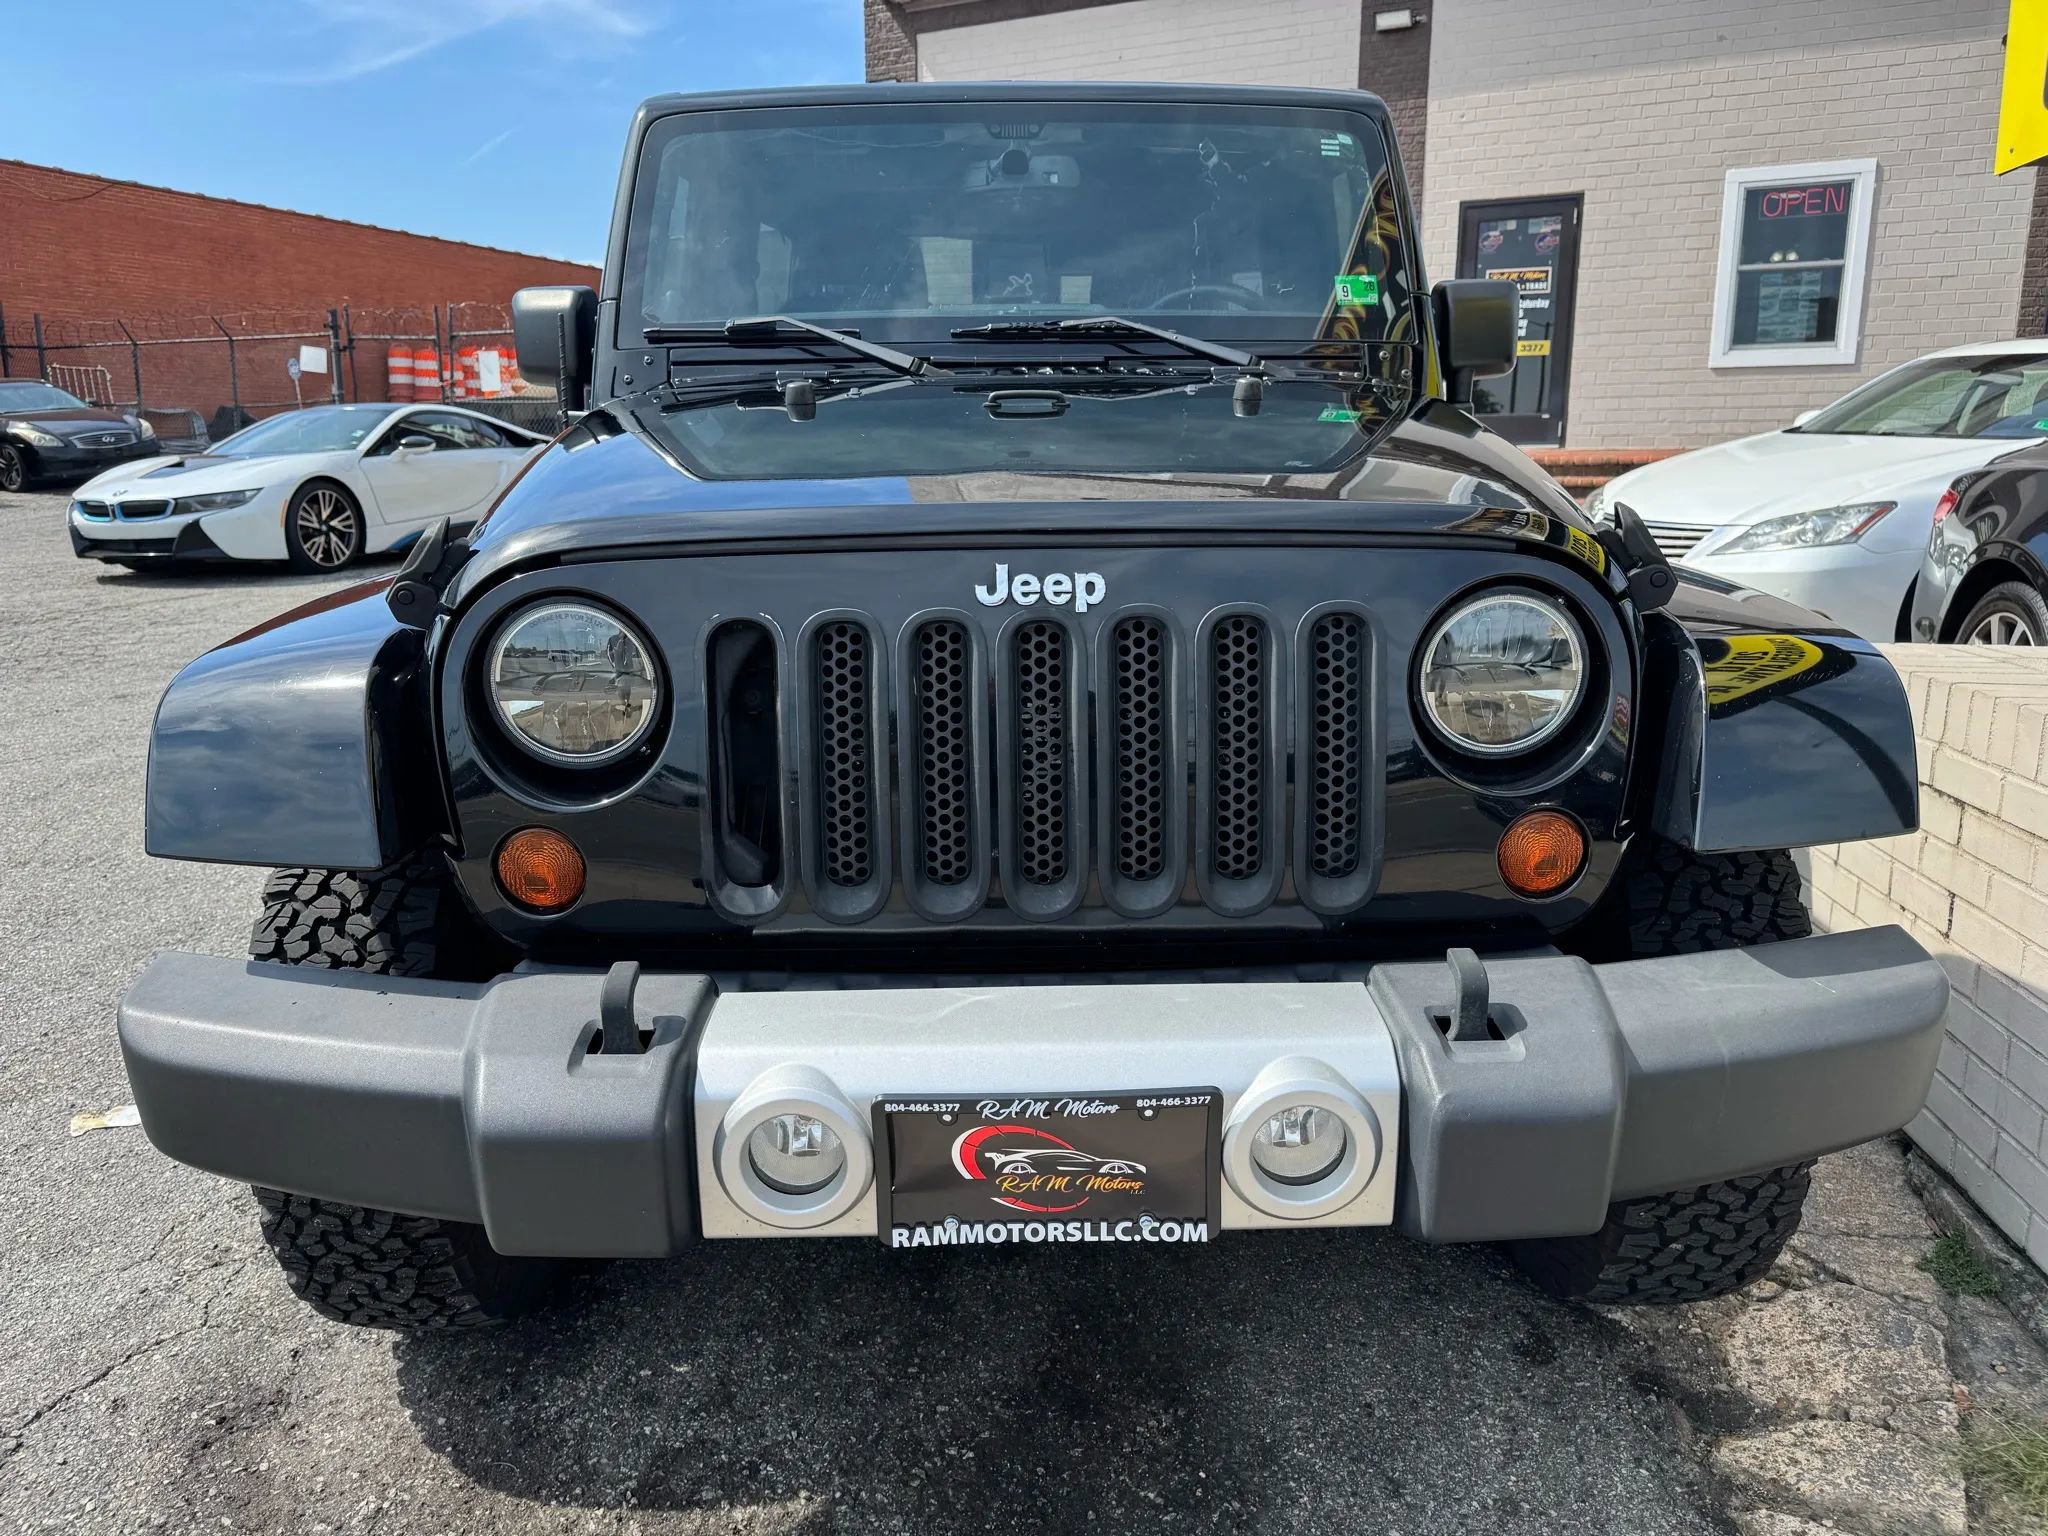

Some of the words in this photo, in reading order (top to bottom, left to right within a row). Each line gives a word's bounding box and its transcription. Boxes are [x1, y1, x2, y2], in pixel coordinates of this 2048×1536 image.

[1763, 187, 1845, 217] OPEN
[1342, 285, 1349, 297] 9
[1520, 343, 1545, 352] 3377
[975, 563, 1107, 613] Jeep
[884, 1102, 960, 1113] 804-466-3377
[1054, 1097, 1121, 1119] Motors
[1136, 1095, 1212, 1108] 804-466-3377
[1075, 1174, 1145, 1193] Motors
[892, 1221, 1208, 1248] RAMMOTORSLLC.COM
